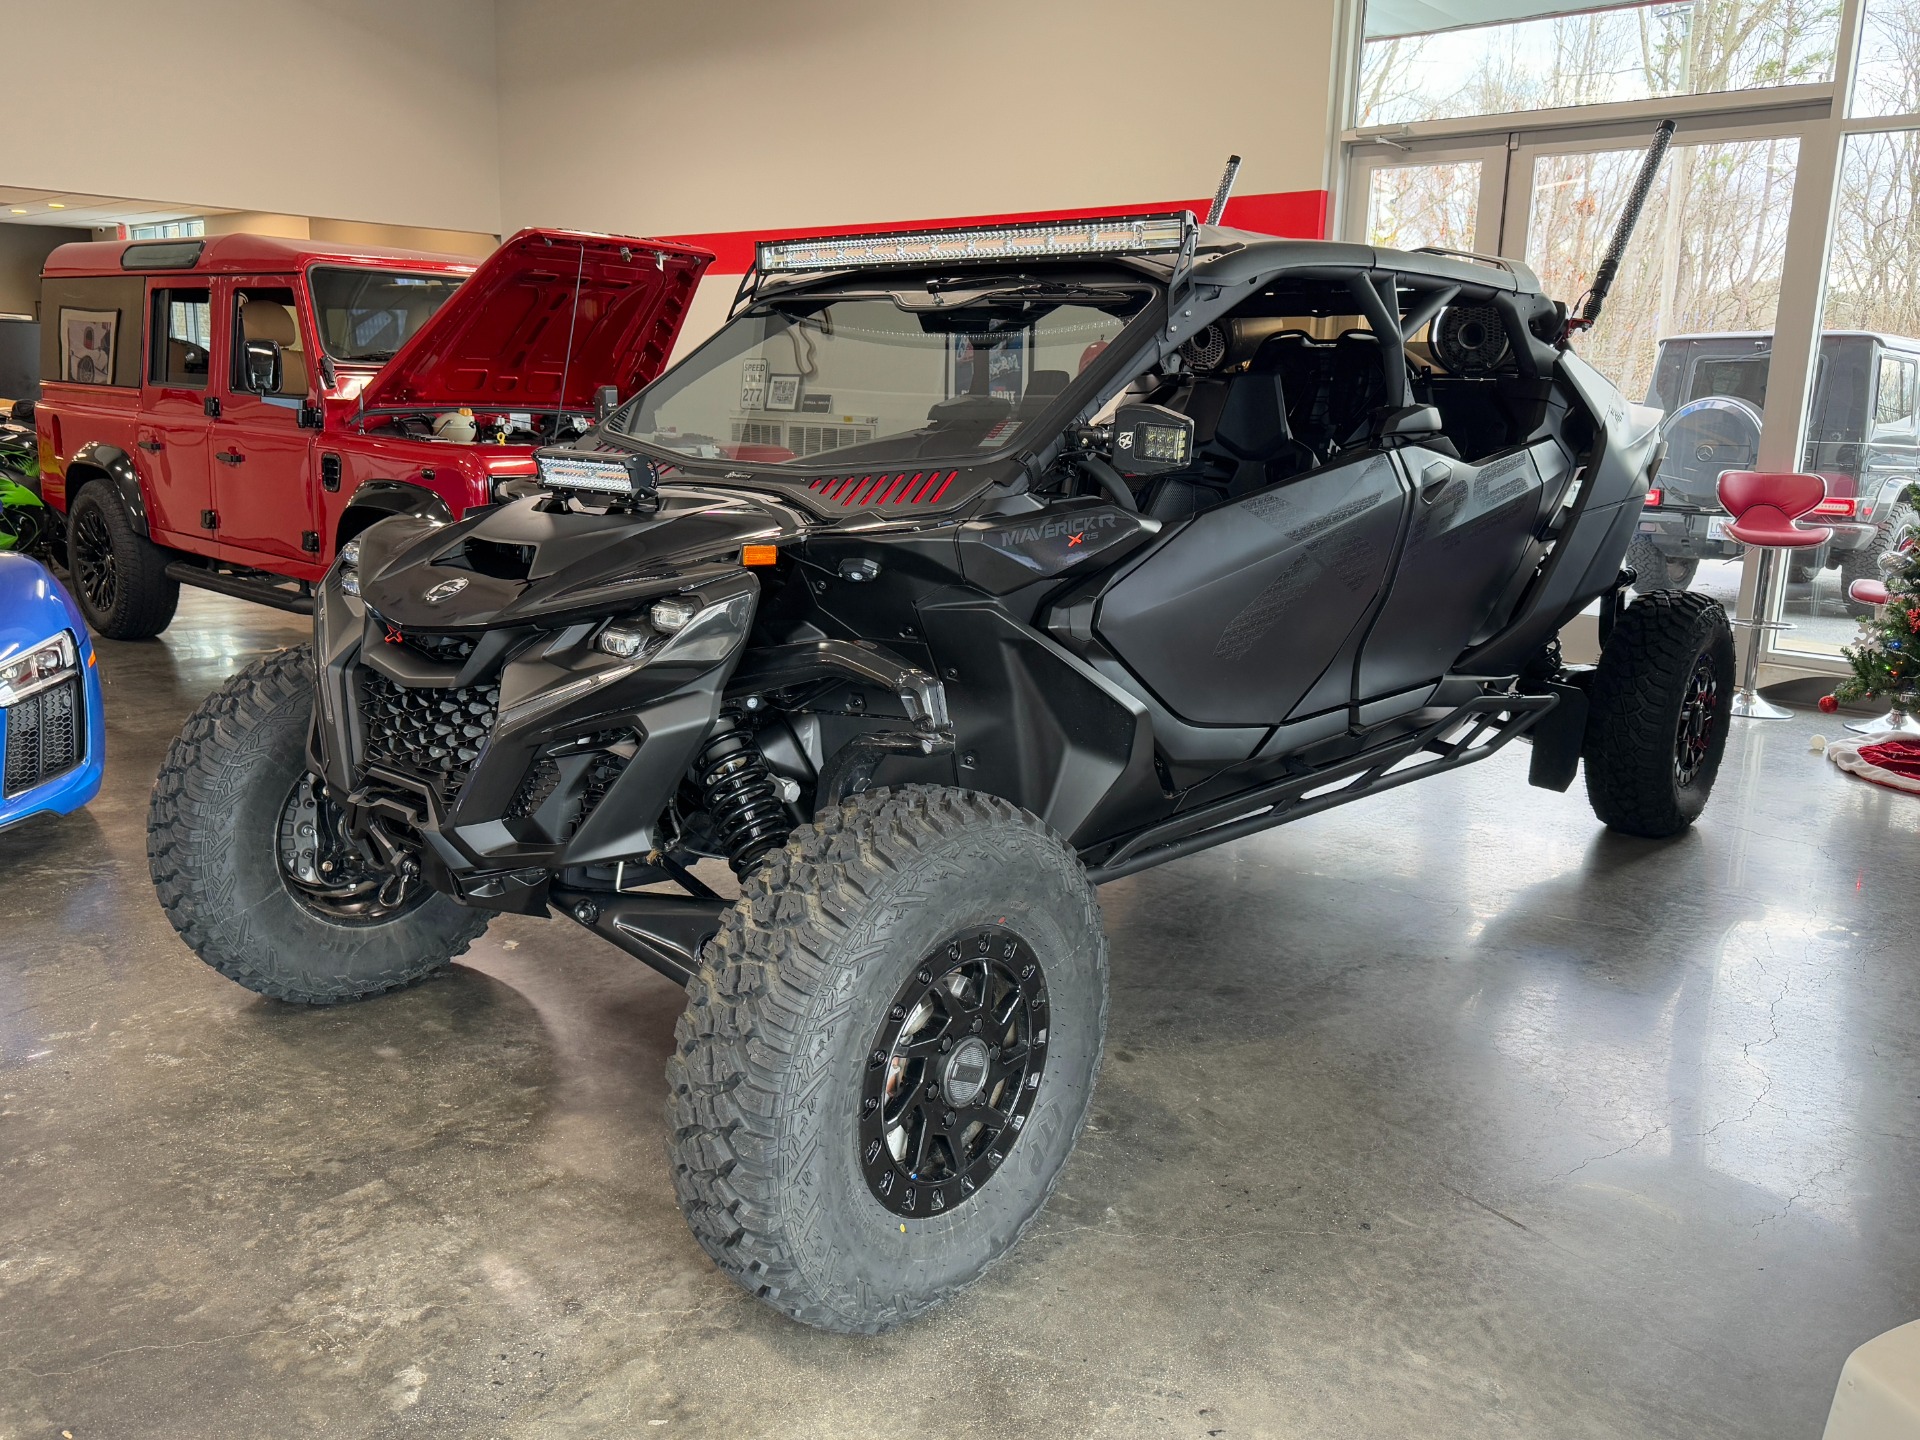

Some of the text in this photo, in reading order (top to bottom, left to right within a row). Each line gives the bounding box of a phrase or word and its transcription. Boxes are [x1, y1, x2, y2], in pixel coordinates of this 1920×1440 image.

[743, 363, 766, 372] SPEED
[744, 374, 762, 383] LIMIT
[742, 388, 763, 402] 277
[1000, 513, 1117, 548] MAVERICK R
